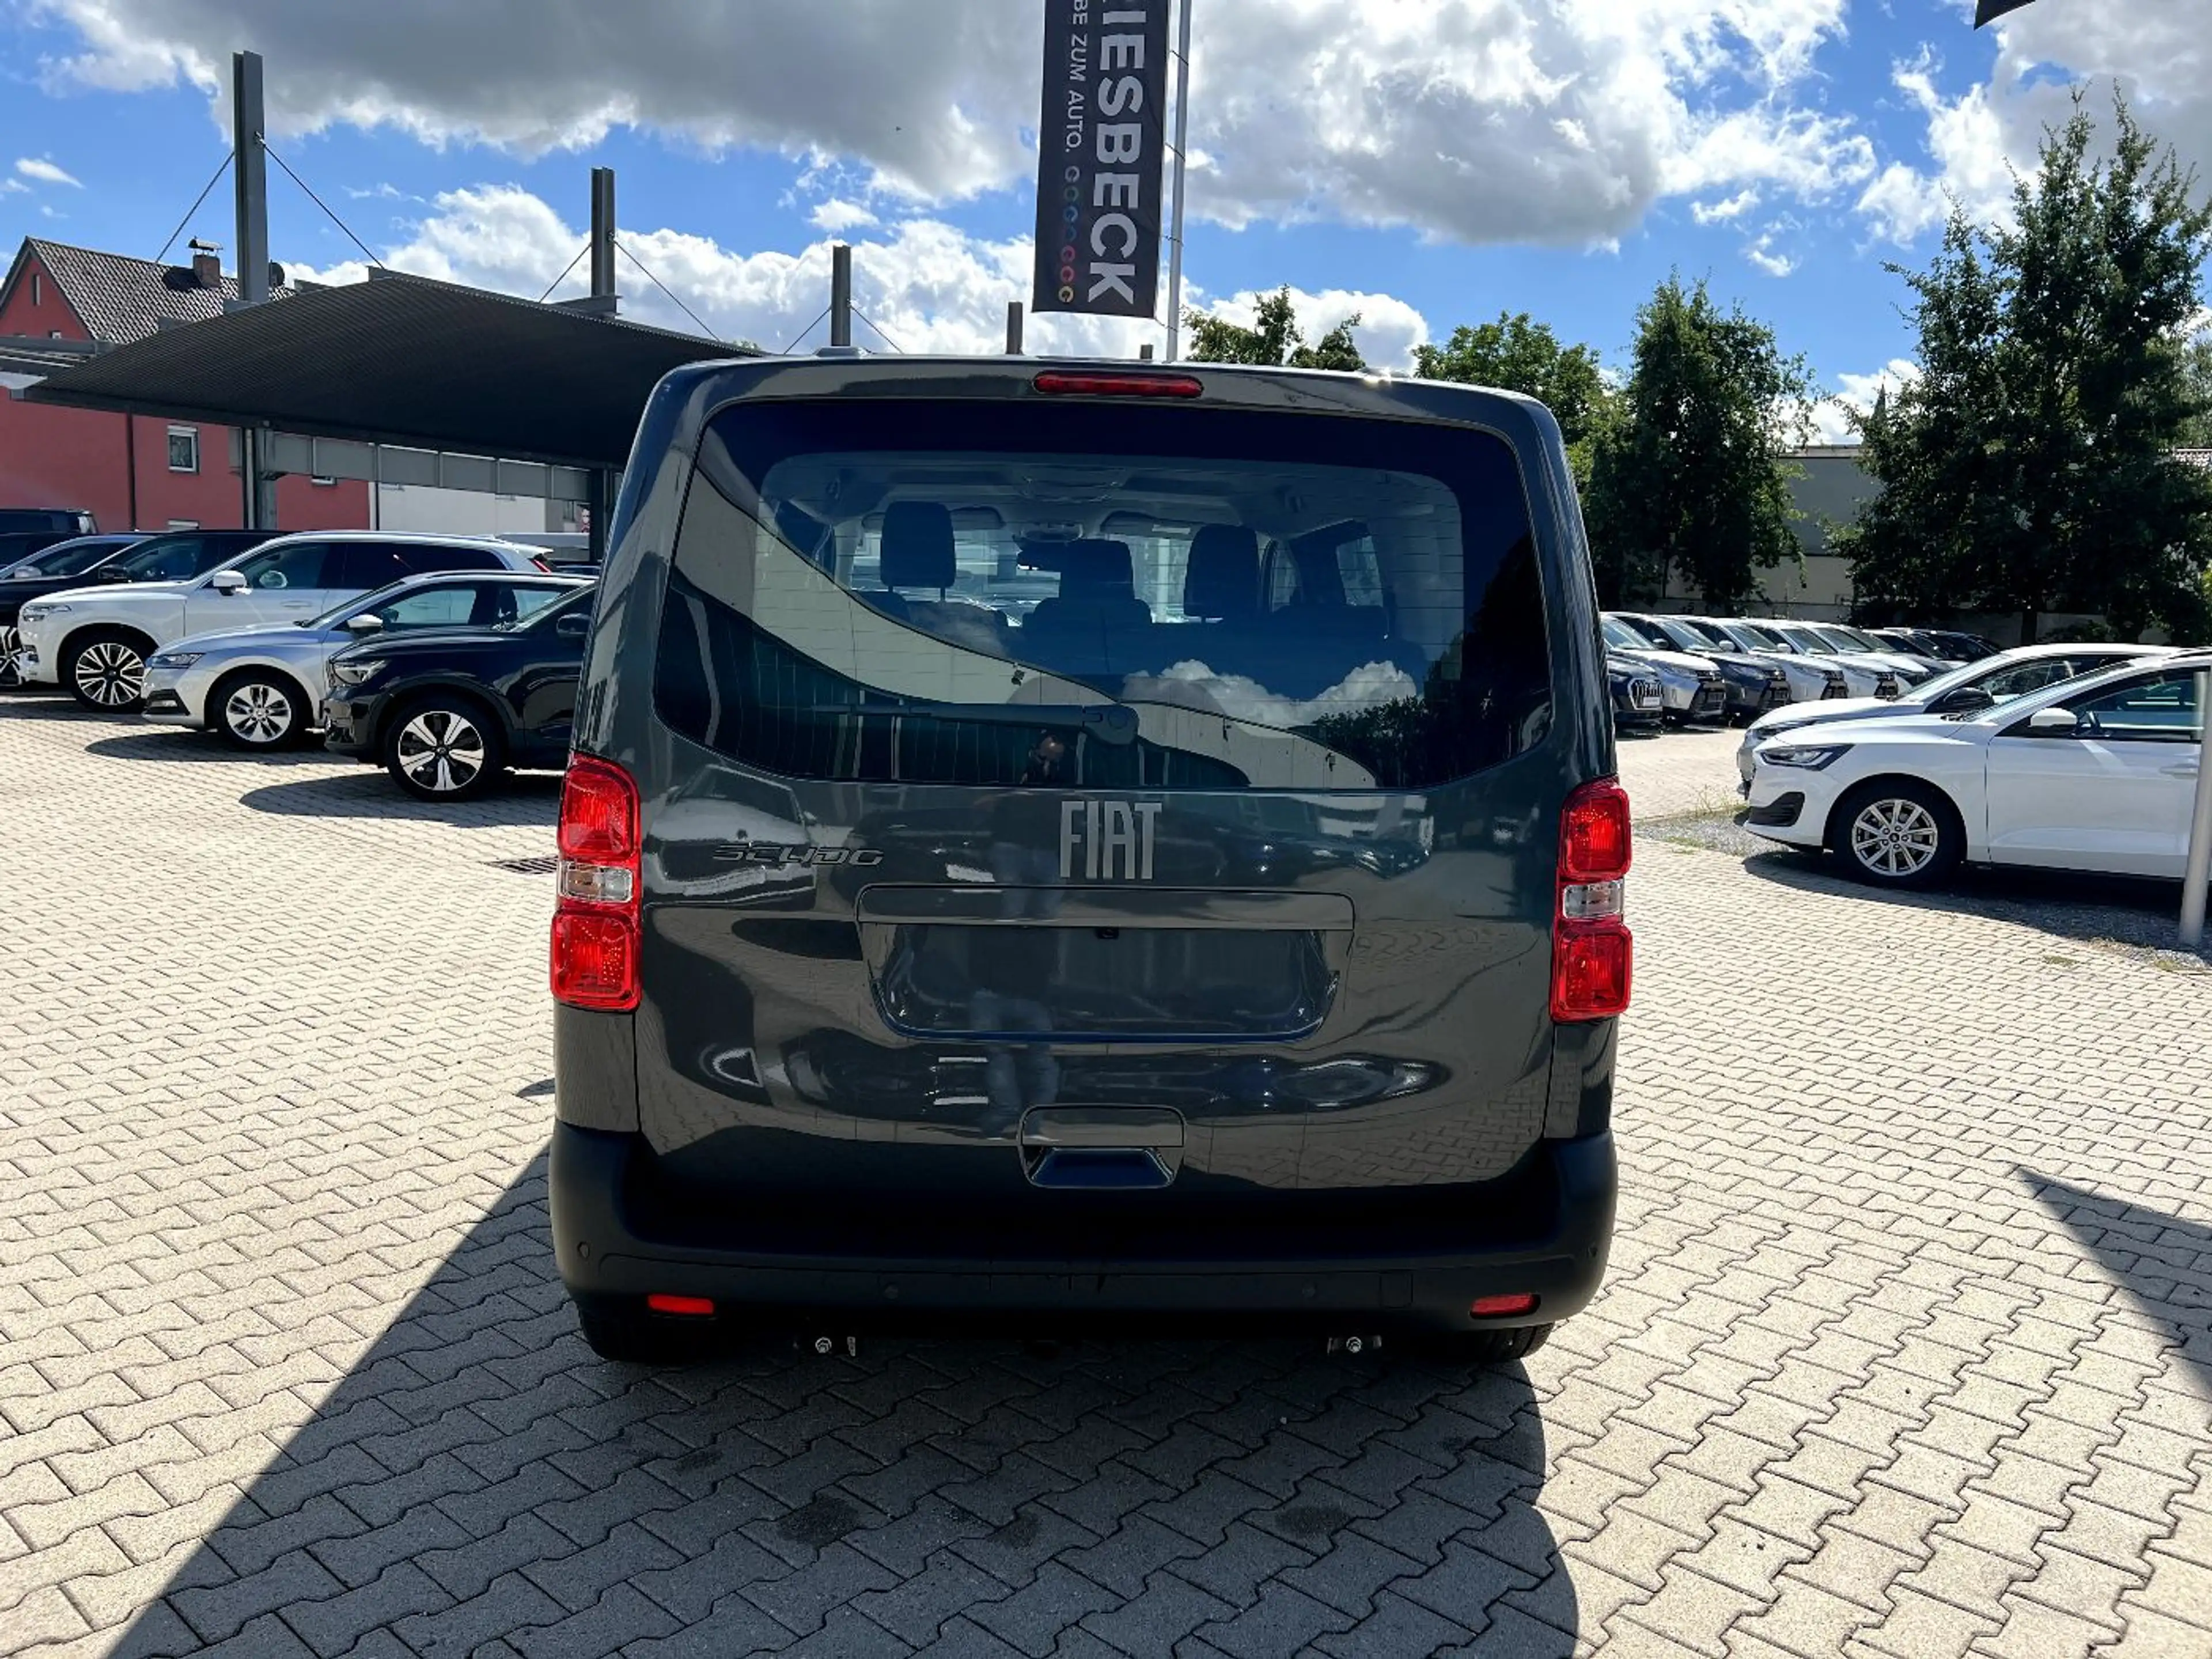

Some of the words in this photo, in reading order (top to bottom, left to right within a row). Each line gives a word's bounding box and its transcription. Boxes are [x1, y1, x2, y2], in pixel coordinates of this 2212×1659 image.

[1069, 33, 1088, 82] ZUM
[1065, 90, 1085, 153] AUTO.
[1088, 0, 1147, 305] IESBECK
[713, 843, 885, 865] SCUDO
[1060, 800, 1162, 880] FIAT
